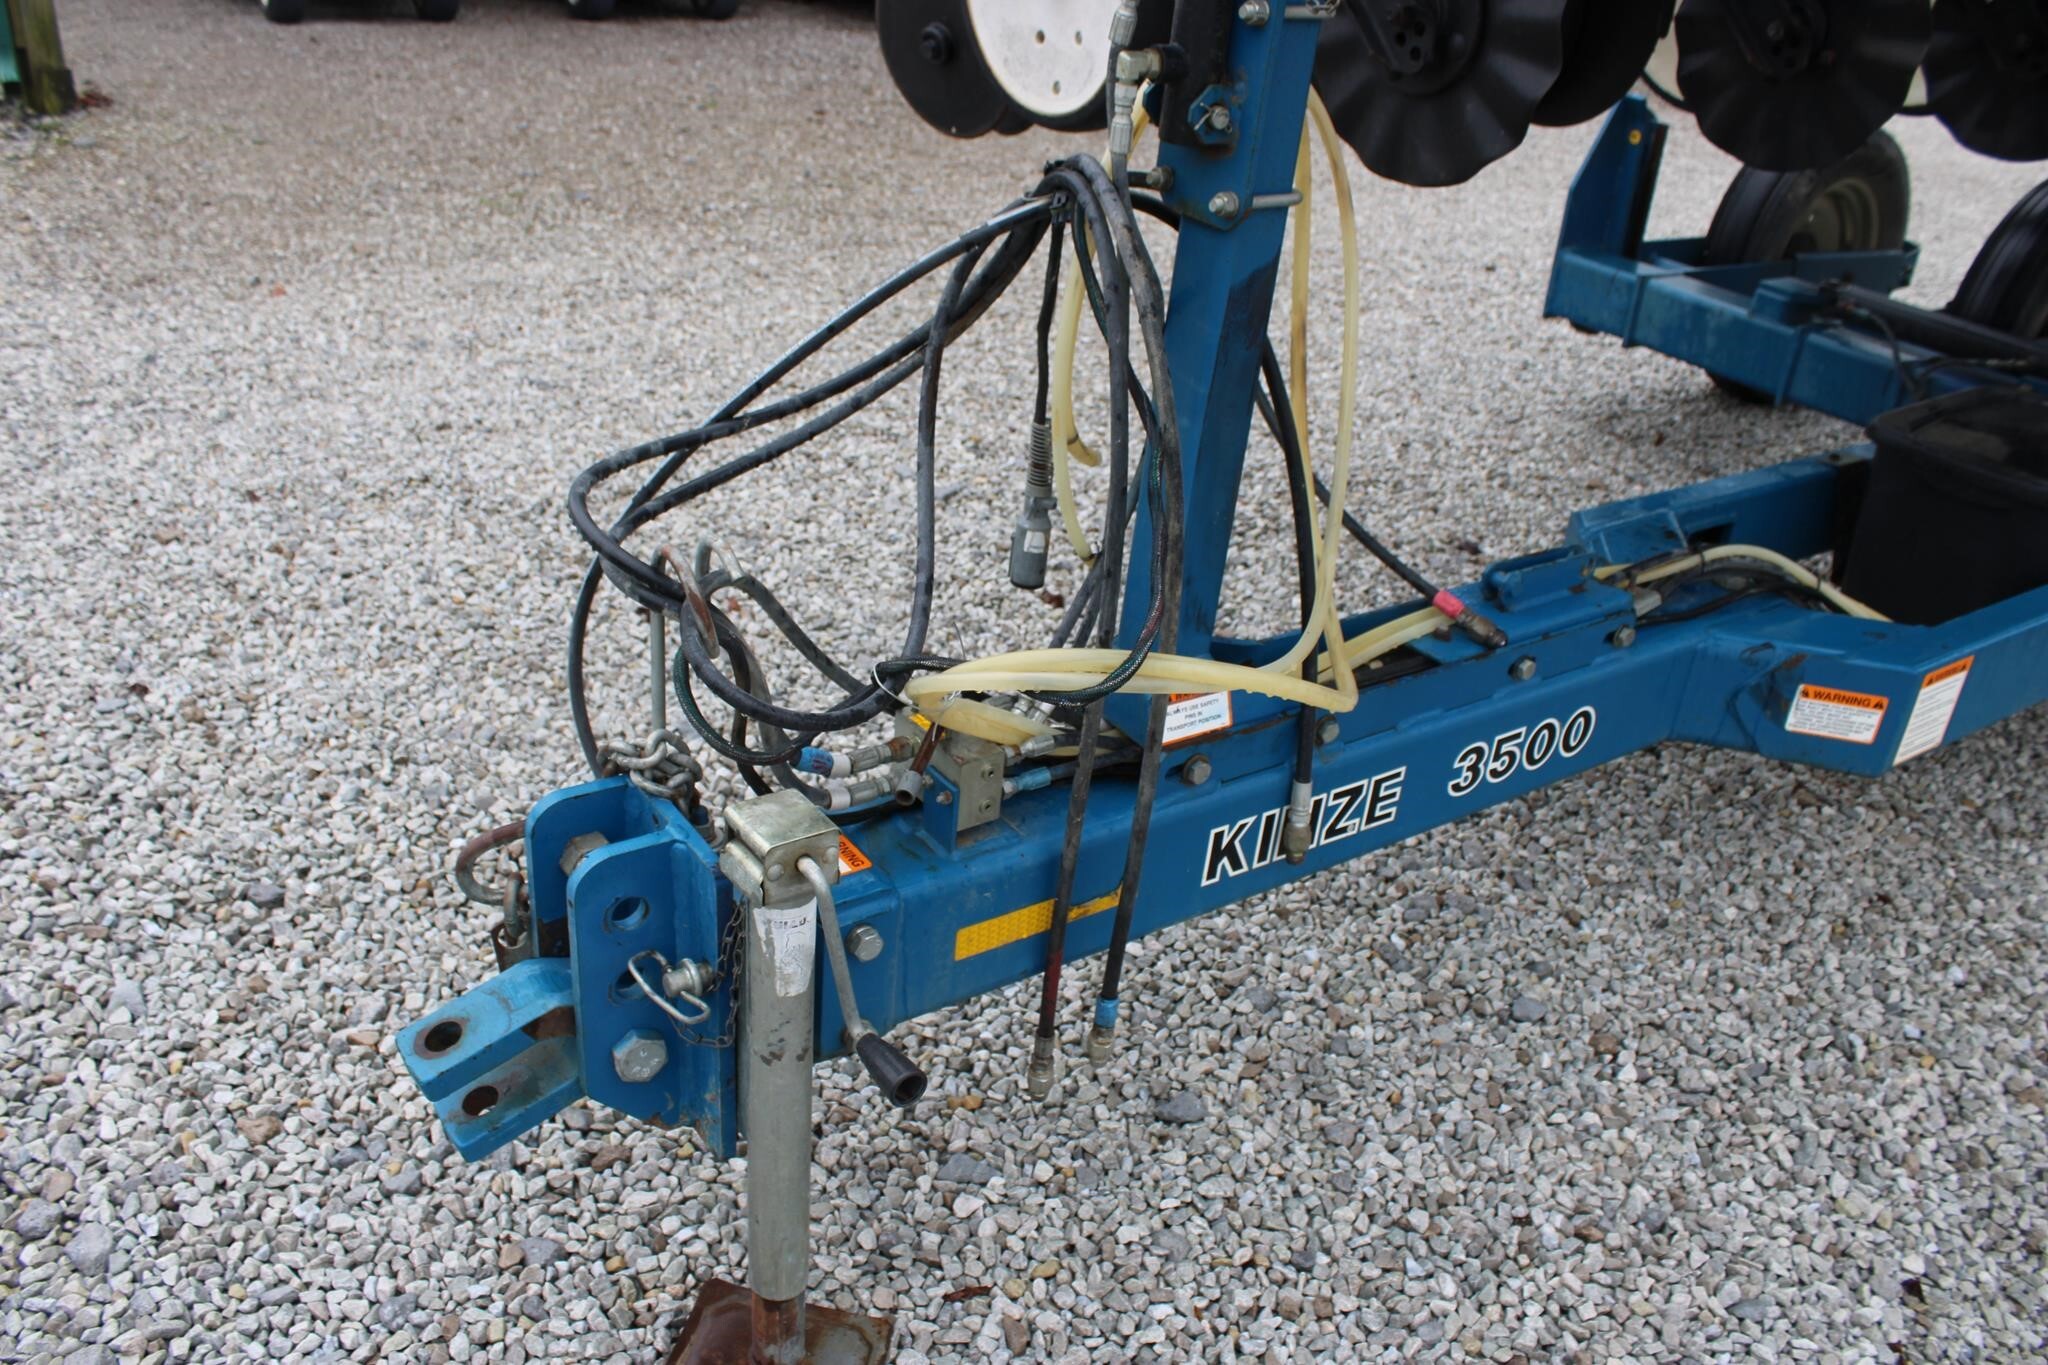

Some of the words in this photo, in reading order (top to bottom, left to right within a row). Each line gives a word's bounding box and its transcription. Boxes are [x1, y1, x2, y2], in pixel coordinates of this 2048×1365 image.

[1200, 698, 1219, 708] SAFETY
[1813, 690, 1871, 708] WARNING
[1167, 720, 1197, 732] TRANSPORT
[1198, 714, 1222, 723] POSITION
[1447, 705, 1597, 797] 3500
[839, 841, 865, 867] RNING
